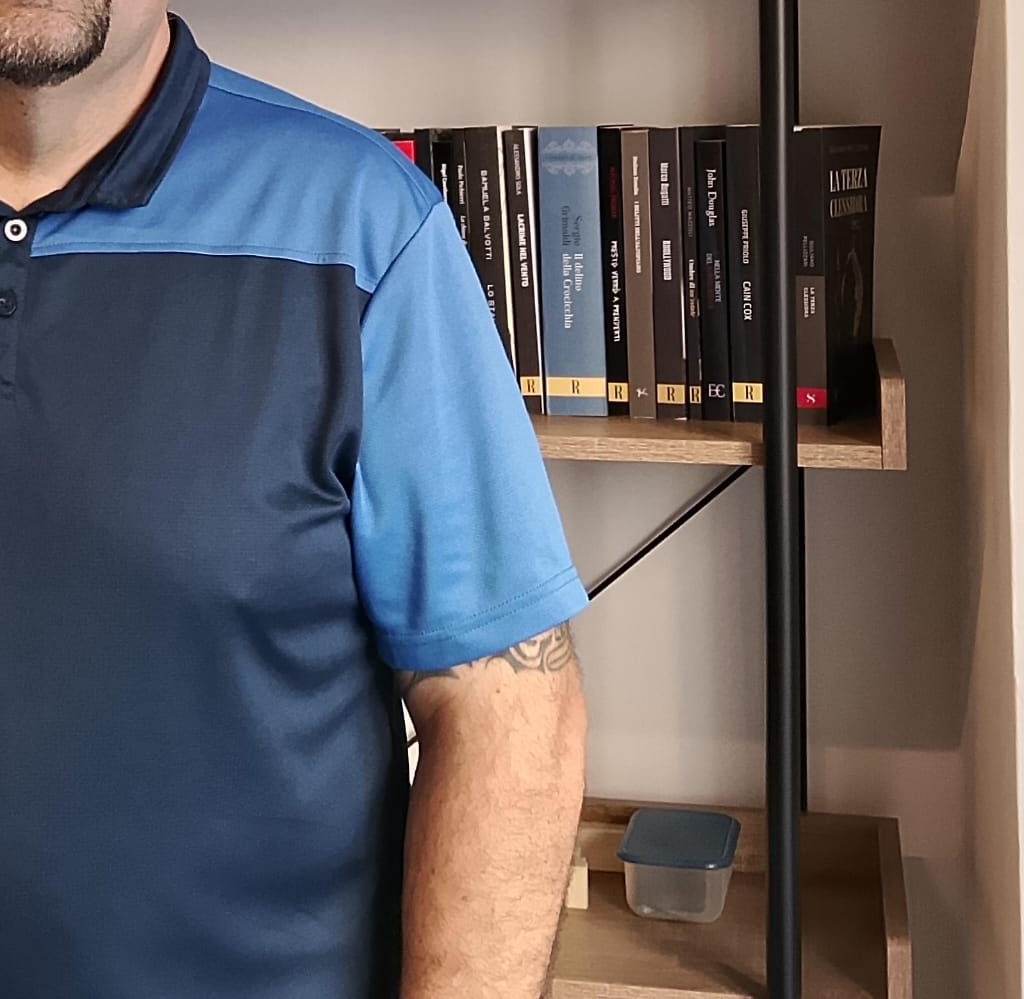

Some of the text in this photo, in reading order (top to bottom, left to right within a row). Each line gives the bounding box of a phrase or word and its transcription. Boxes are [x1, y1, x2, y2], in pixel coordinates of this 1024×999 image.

[513, 143, 522, 179] ALESSANDRO
[829, 167, 868, 193] LA TERZA
[705, 169, 718, 227] John Douglas
[561, 205, 572, 246] Grimaldi
[573, 215, 583, 246] Sergio
[741, 209, 749, 239] GIUSEPPE
[517, 213, 528, 287] LACRIME NEL VENTO
[487, 284, 495, 297] LO
[562, 253, 574, 329] della Crocicchia
[574, 262, 584, 291] delitto
[742, 281, 753, 321] CAIN COX
[745, 384, 754, 400] R
